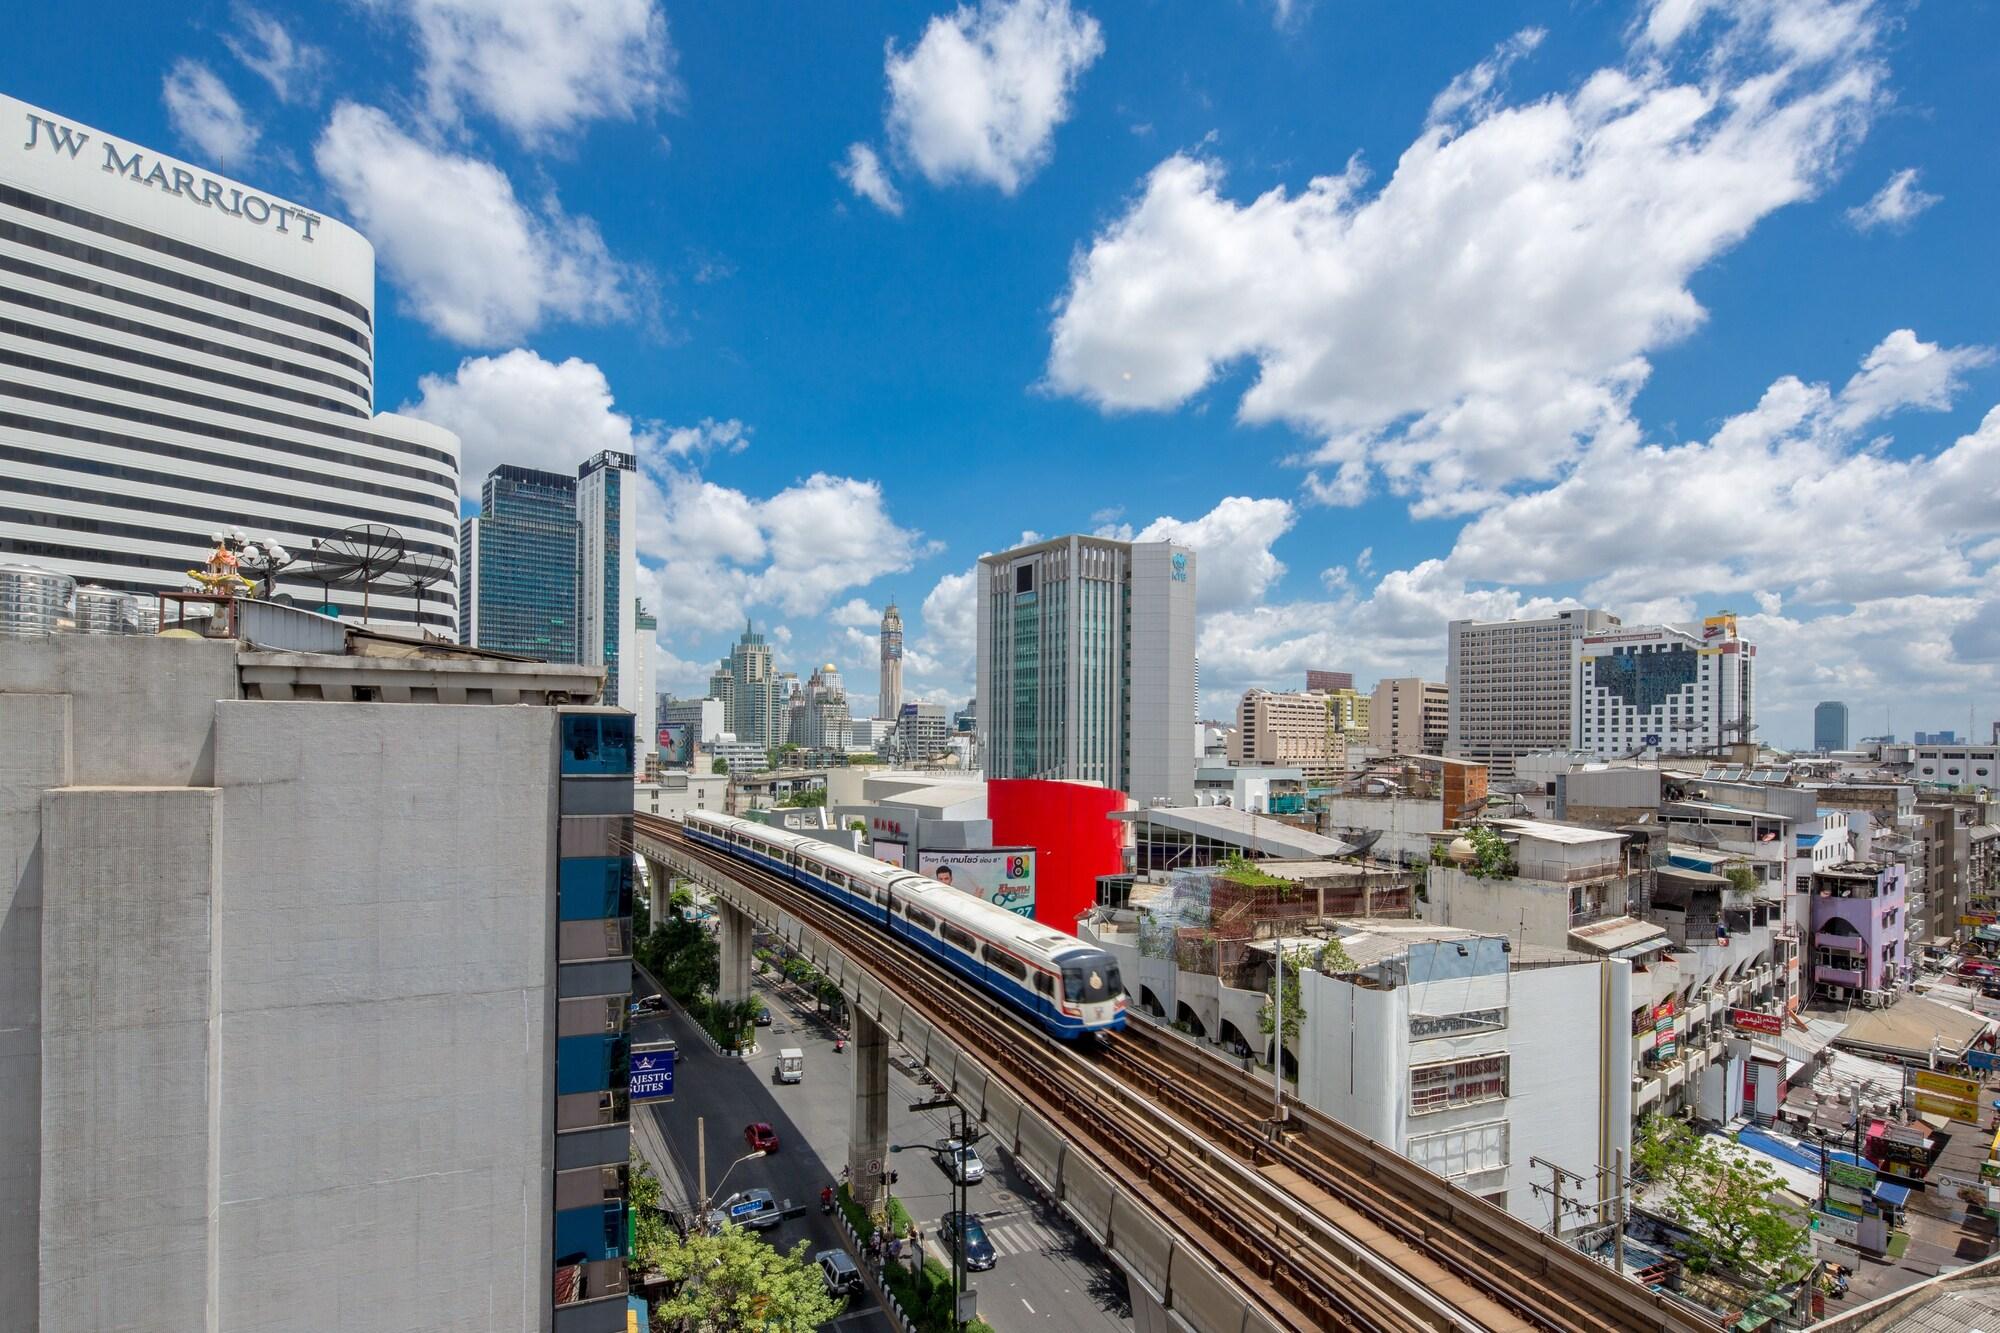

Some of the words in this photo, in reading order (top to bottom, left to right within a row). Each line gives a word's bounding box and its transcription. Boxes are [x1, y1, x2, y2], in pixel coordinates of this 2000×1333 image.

[24, 113, 90, 159] JW
[102, 142, 321, 243] MARRIOTT
[631, 1072, 672, 1086] AJESTIC
